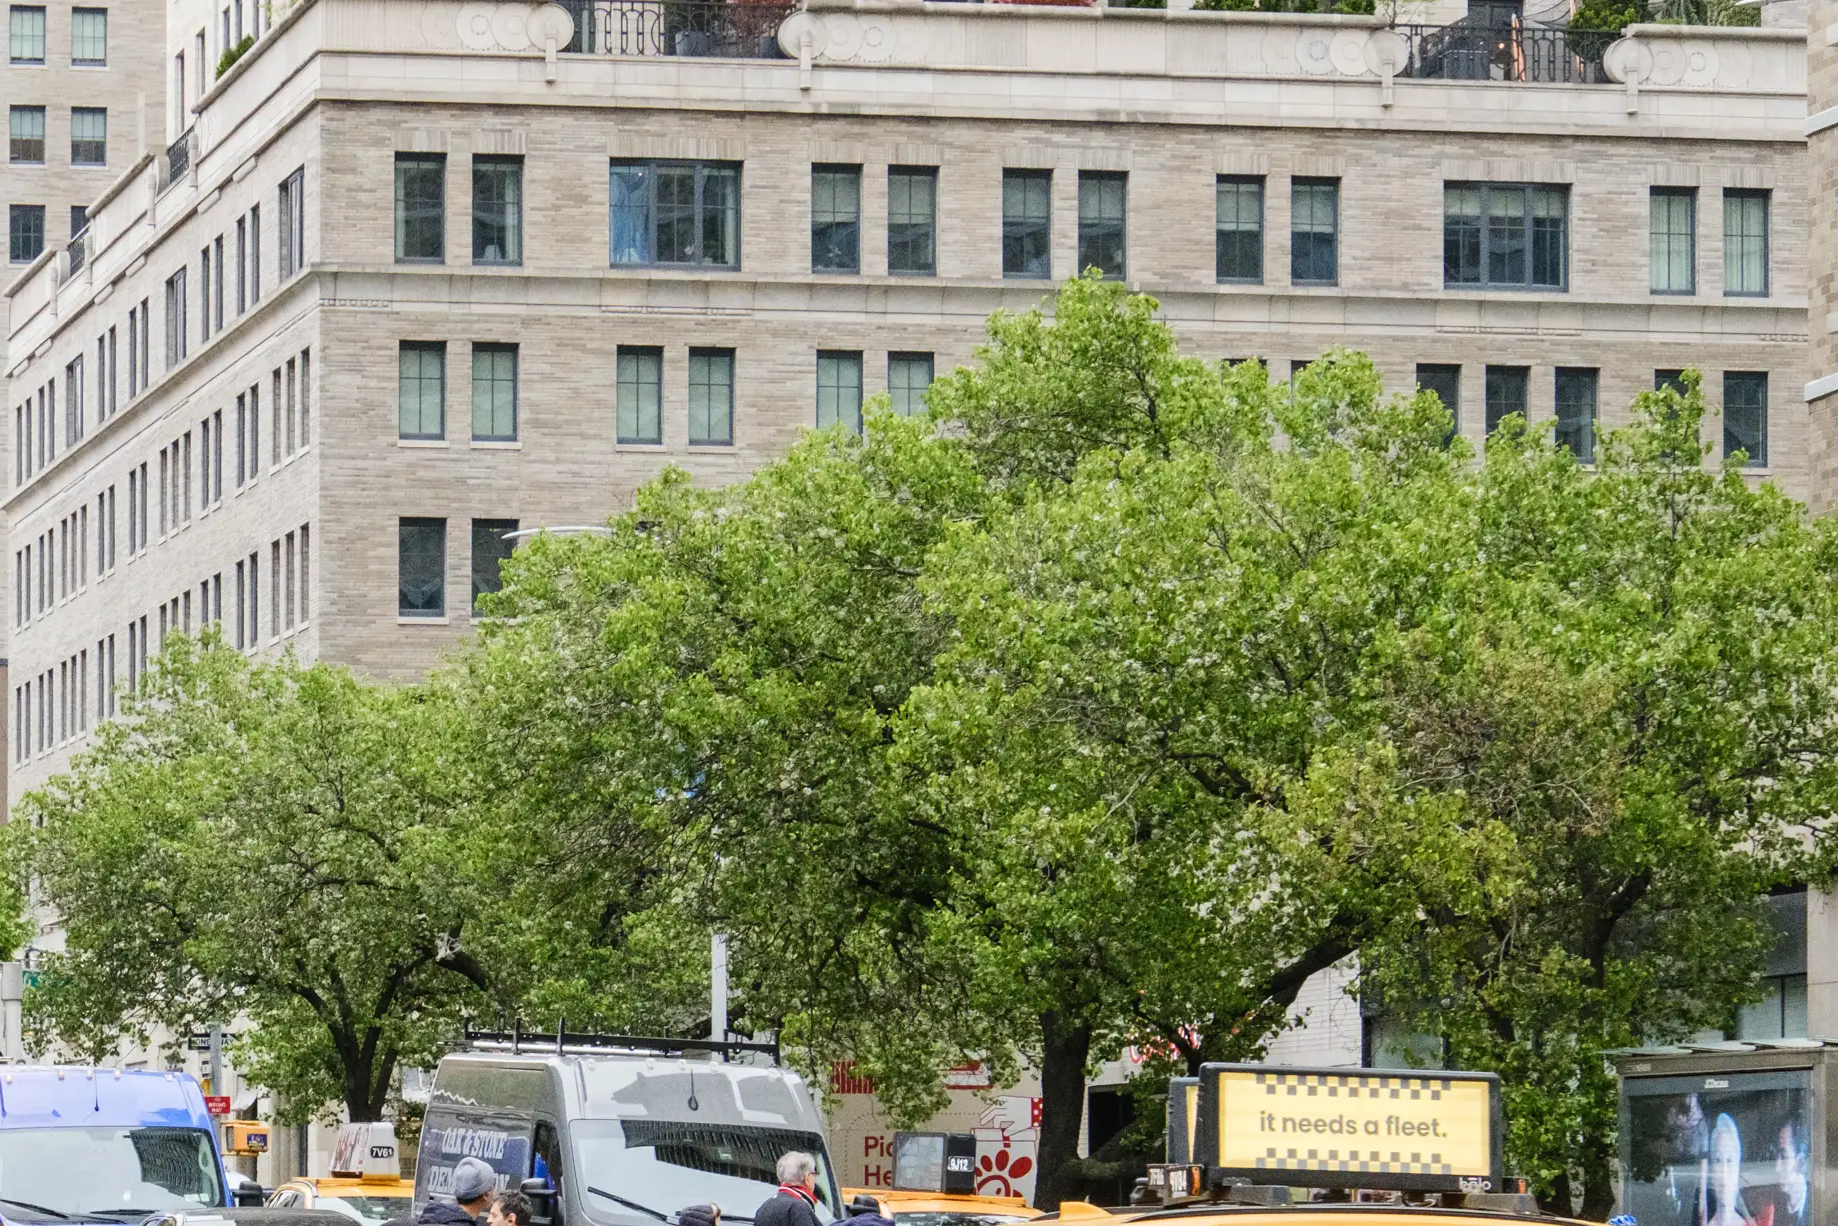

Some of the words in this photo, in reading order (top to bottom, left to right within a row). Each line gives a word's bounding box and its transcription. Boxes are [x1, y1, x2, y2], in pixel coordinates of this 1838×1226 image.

[1260, 1110, 1276, 1132] it
[1282, 1114, 1358, 1134] needs
[1363, 1117, 1379, 1136] a
[1385, 1115, 1448, 1138] fleet.
[442, 1127, 466, 1154] OAK
[470, 1130, 508, 1159] STONE
[864, 1136, 894, 1157] Pic
